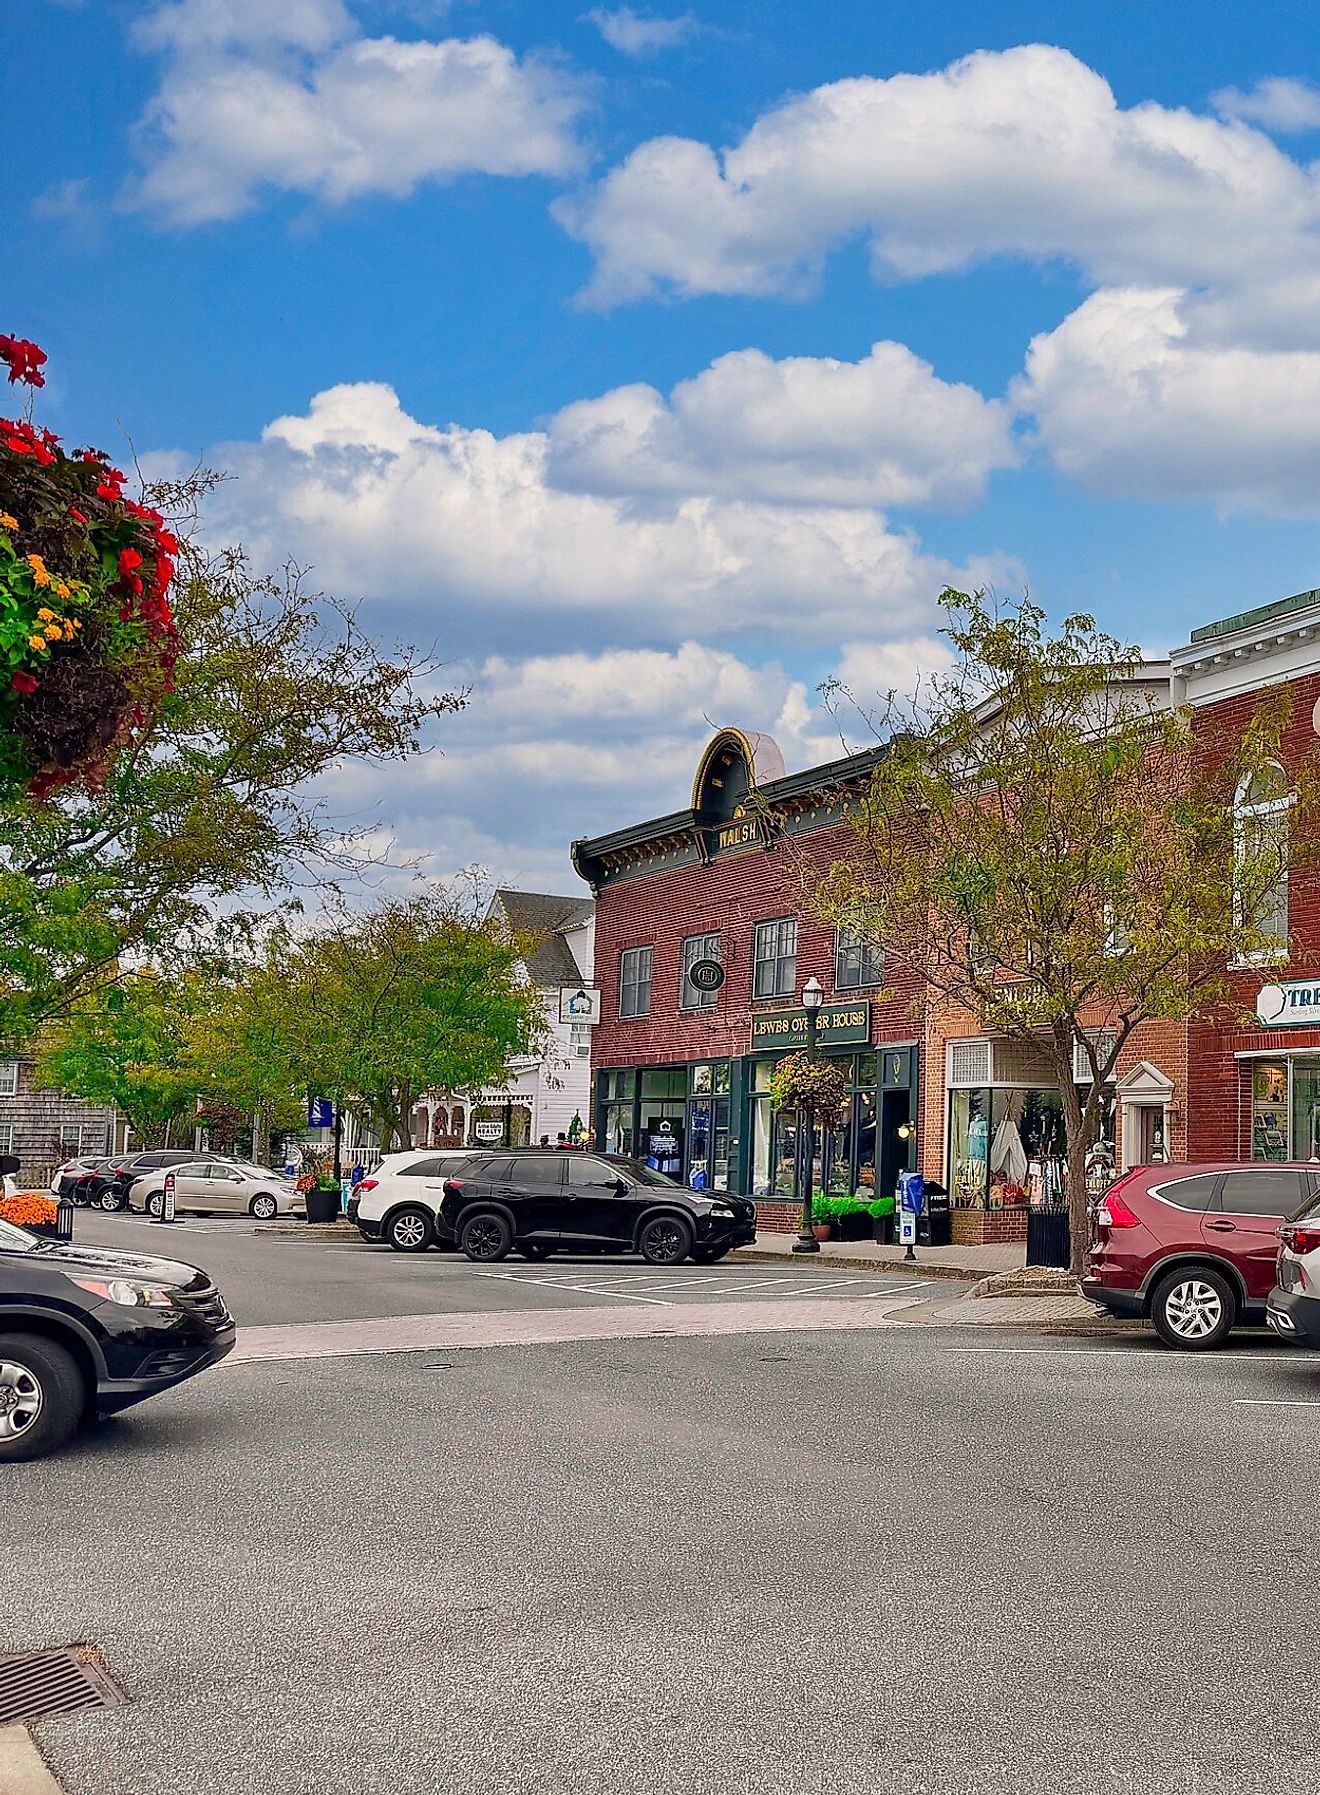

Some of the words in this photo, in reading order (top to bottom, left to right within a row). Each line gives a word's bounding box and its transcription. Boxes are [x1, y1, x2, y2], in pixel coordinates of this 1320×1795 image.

[719, 822, 756, 848] WALSH
[753, 1019, 789, 1036] LEWES
[832, 1010, 866, 1028] HOUSE
